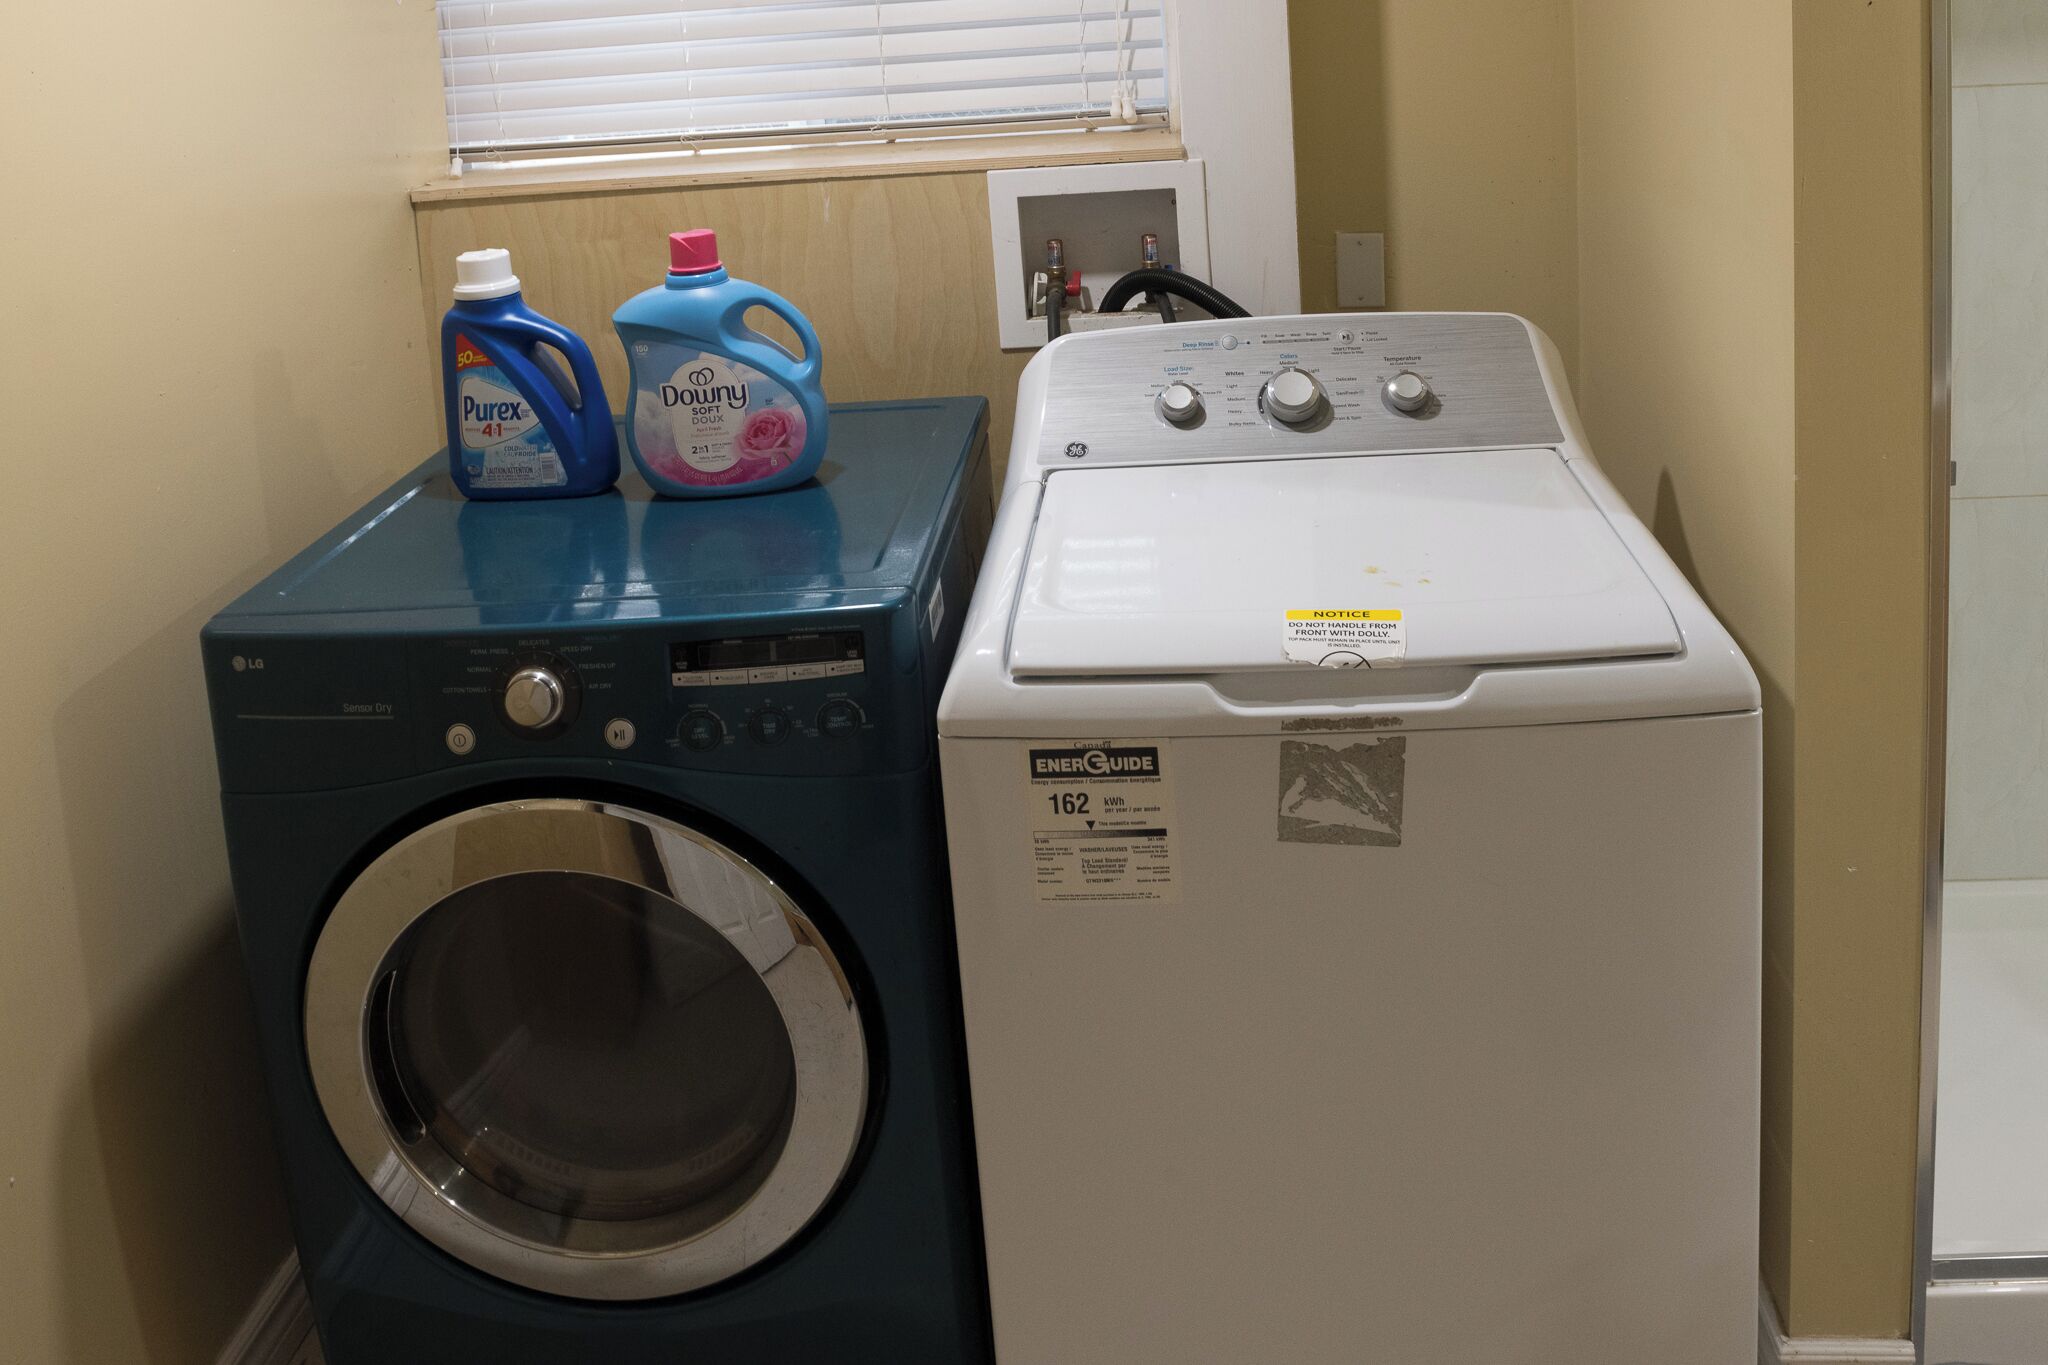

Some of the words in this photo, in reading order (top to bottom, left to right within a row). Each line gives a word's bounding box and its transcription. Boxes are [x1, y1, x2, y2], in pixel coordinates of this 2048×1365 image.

[661, 383, 747, 410] Downy
[464, 396, 522, 422] Purex
[692, 406, 721, 416] SOFT
[692, 415, 724, 425] DOUX
[247, 659, 264, 669] LG
[343, 703, 372, 712] Sensor
[375, 703, 392, 714] Dry
[1036, 750, 1154, 774] ENERGUIDE
[1048, 793, 1090, 814] 162
[1104, 797, 1124, 806] kWh
